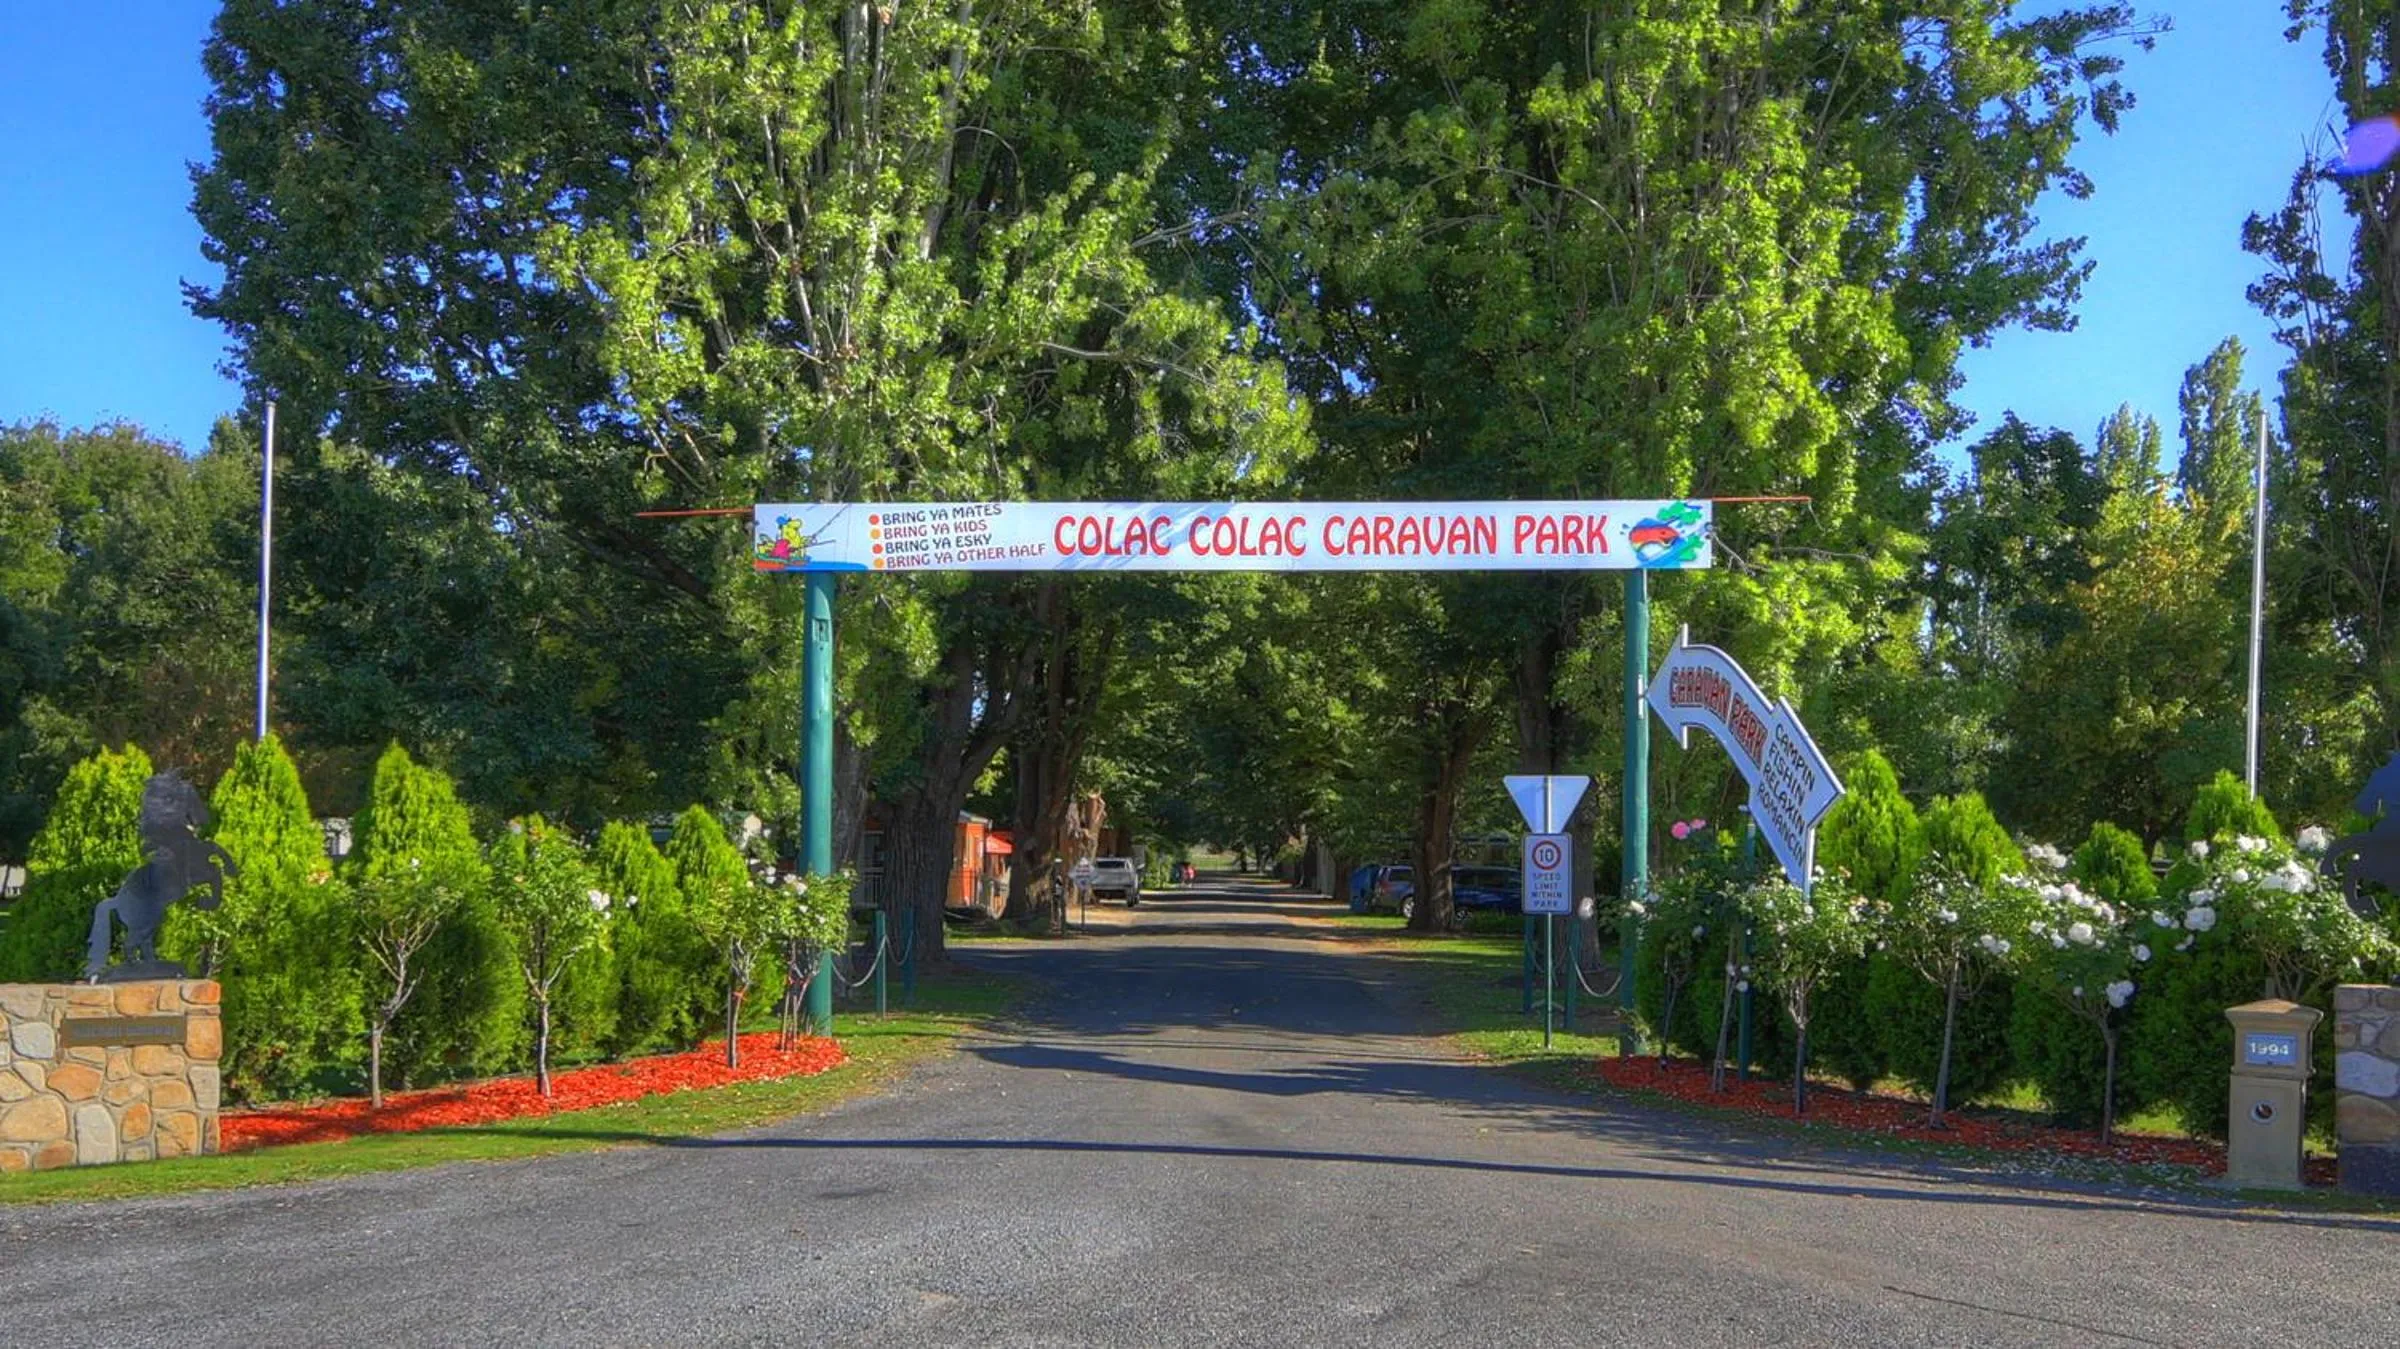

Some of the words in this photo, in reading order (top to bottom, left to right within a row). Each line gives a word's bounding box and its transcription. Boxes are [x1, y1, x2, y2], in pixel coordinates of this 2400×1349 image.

[882, 510, 926, 526] BRING
[929, 507, 949, 521] YA
[952, 503, 1003, 519] MATES
[883, 525, 928, 540] BRING
[931, 522, 950, 535] YA
[953, 519, 988, 534] KIDS
[1053, 514, 1172, 557] COLAC
[1188, 514, 1307, 557] COLAC
[1322, 514, 1498, 557] CARAVAN
[1513, 514, 1609, 555] PARK
[885, 538, 930, 554] BRING
[932, 536, 951, 550] YA
[955, 533, 992, 548] ESKY
[886, 553, 931, 569] BRING
[934, 551, 953, 564] YA
[957, 545, 1006, 562] OTHER
[1009, 542, 1046, 558] HALF
[1669, 665, 1732, 724] CARAVAN
[1728, 691, 1768, 771] PARK
[1775, 722, 1816, 792] CAMPIN
[1769, 741, 1806, 807] FISHIN
[1763, 763, 1806, 837] RELAXIN
[1538, 848, 1554, 863] 10
[1532, 872, 1561, 881] SPEED
[1534, 882, 1559, 890] LIMIT
[1531, 891, 1563, 899] WITHIN
[1533, 900, 1559, 908] PARK
[2250, 1041, 2289, 1056] 1994
